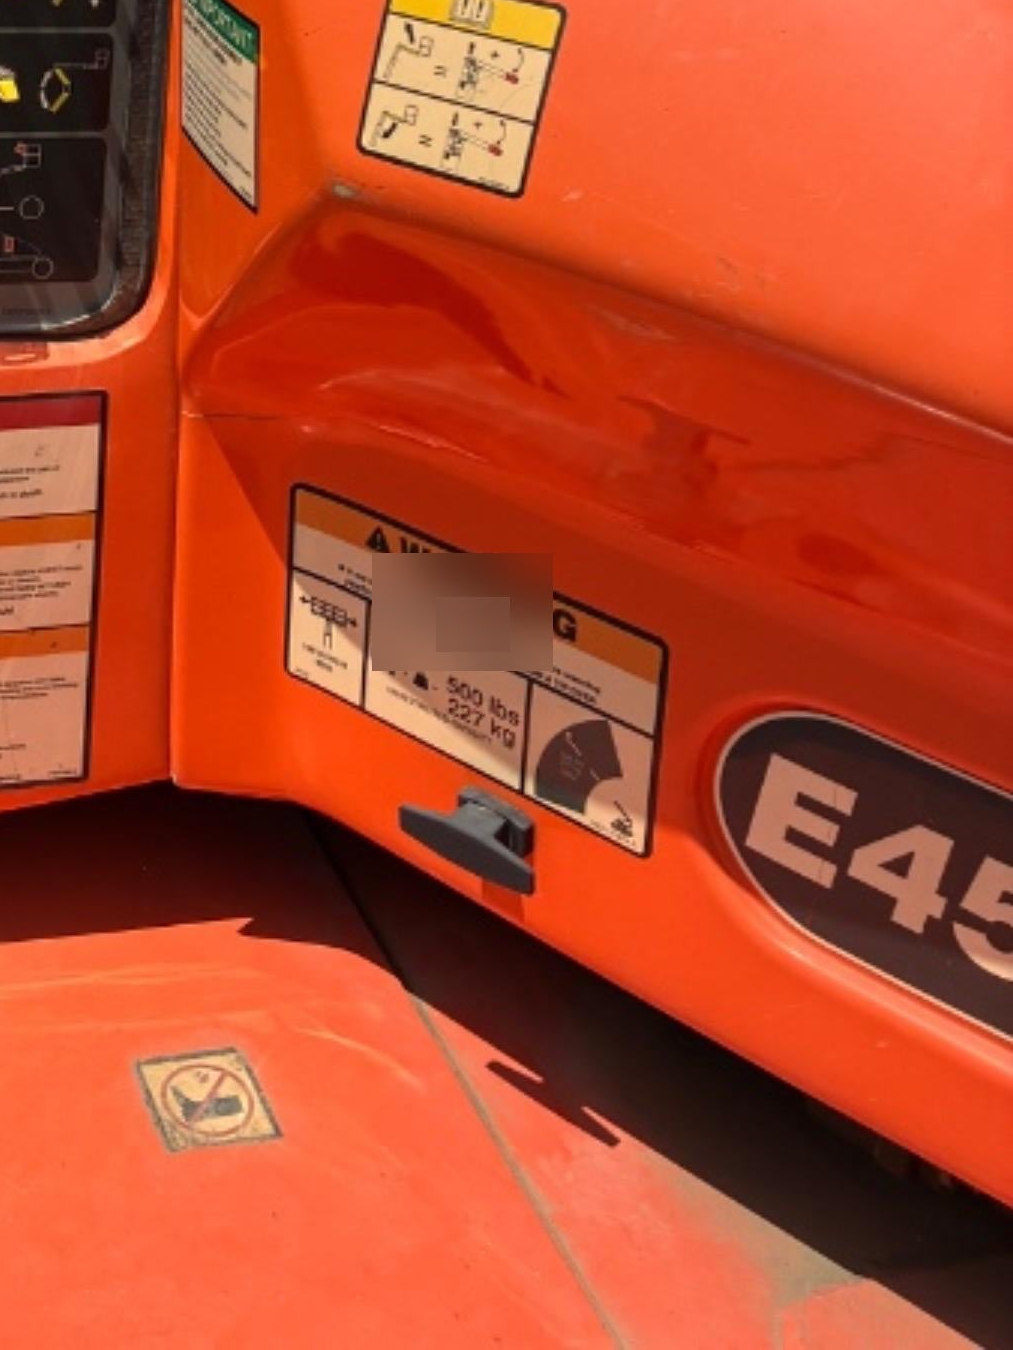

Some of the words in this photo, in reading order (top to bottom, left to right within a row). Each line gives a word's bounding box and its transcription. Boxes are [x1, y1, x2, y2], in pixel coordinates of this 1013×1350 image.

[447, 676, 483, 709] 500
[490, 696, 519, 727] lbs
[448, 698, 485, 728] 227
[490, 718, 516, 749] kg
